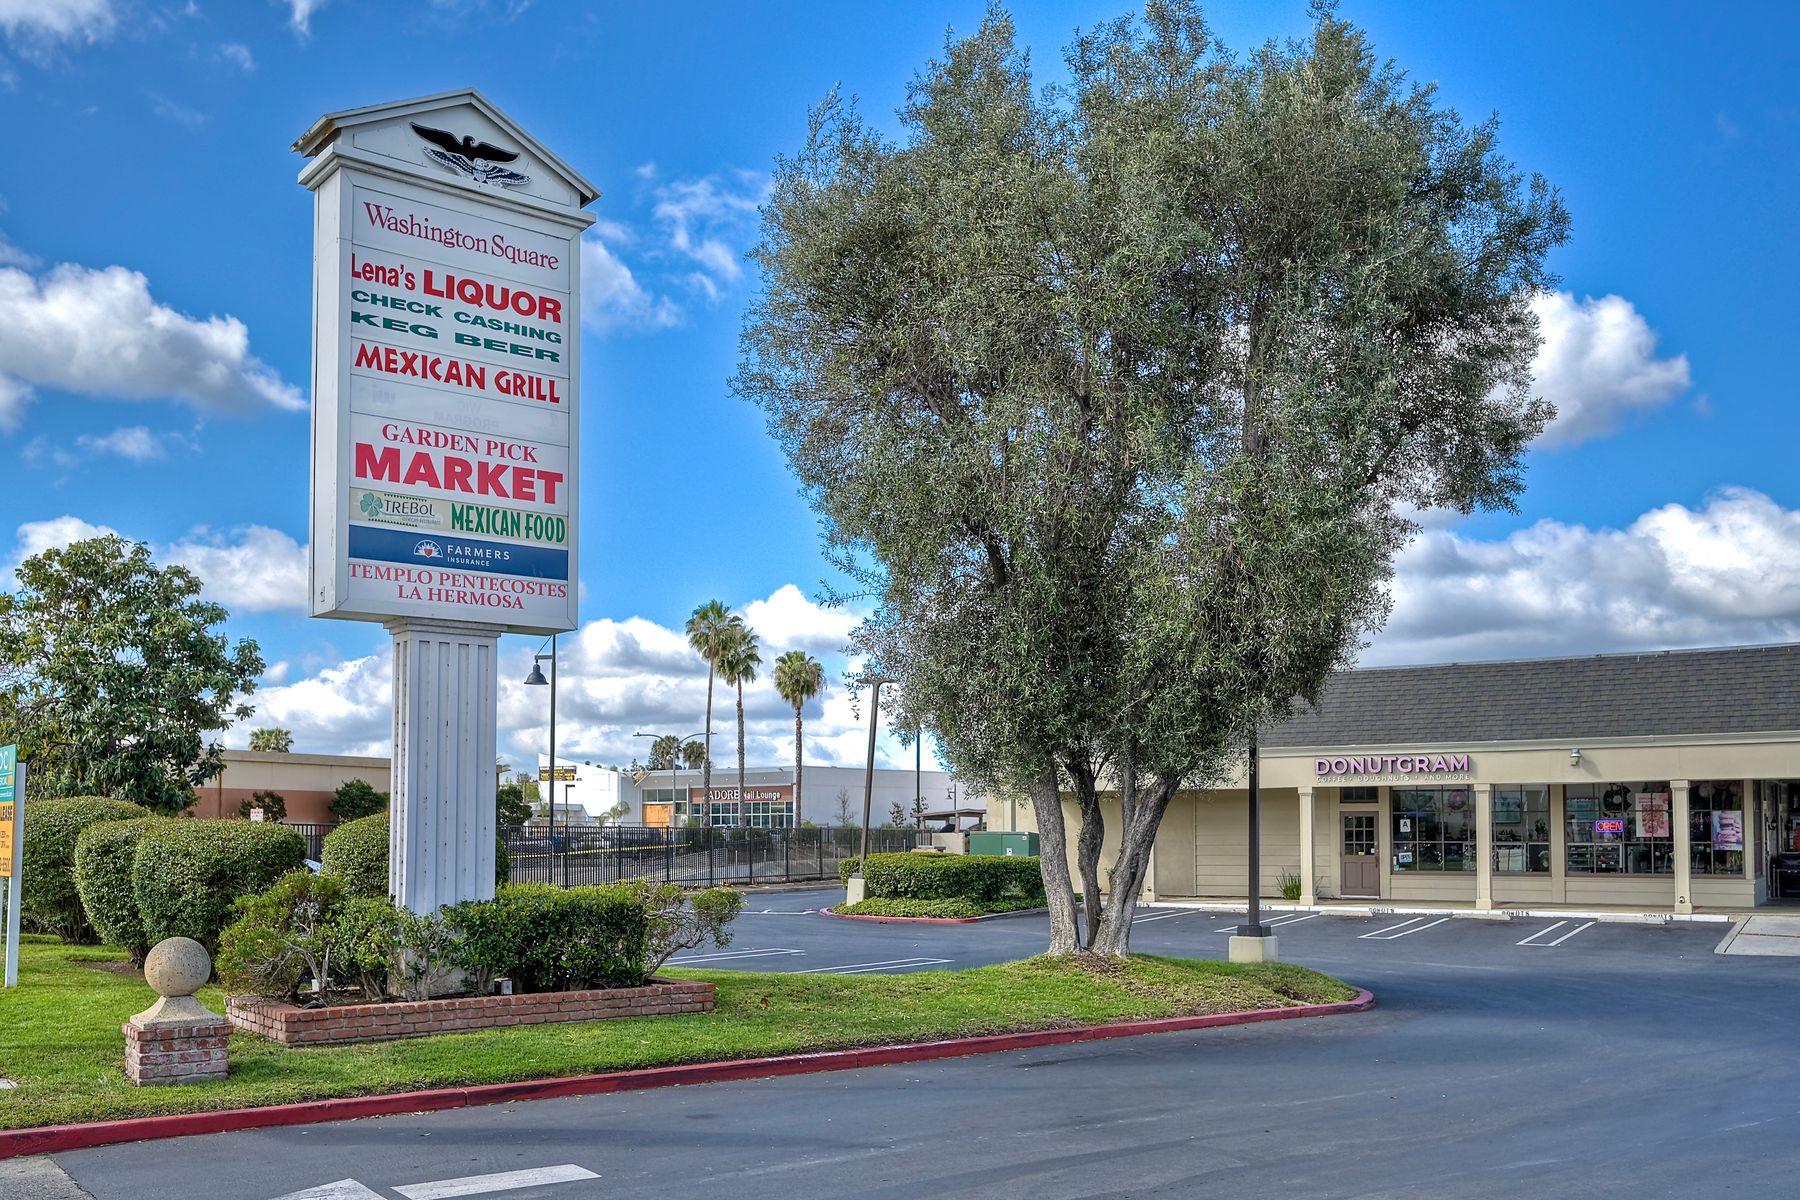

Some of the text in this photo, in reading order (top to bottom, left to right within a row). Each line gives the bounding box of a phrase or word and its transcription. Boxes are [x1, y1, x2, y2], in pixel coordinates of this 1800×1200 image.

[363, 201, 559, 271] Washington Square
[351, 253, 562, 324] Lena's LIQUOR
[351, 290, 562, 345] CHECK CASHING
[351, 311, 560, 363] KEG BEER
[355, 343, 560, 404] MEXICAN GRILL
[382, 423, 538, 463] GARDEN PICK
[355, 442, 563, 505] MARKET
[451, 503, 565, 543] MEXICAN FOOD
[447, 544, 510, 561] FARMERS
[447, 556, 490, 567] INSURANCE
[349, 563, 567, 598] TEMPLO PENTECOSTES
[398, 585, 524, 609] LA HERMOSA
[1314, 754, 1470, 775] DONUTGRAM
[1316, 775, 1347, 783] COFFEE
[1357, 774, 1410, 782] DOUGHNUTS
[1445, 773, 1470, 781] MORE
[756, 791, 781, 801] Lounge
[1402, 820, 1409, 828] A
[1597, 822, 1622, 831] OPEN
